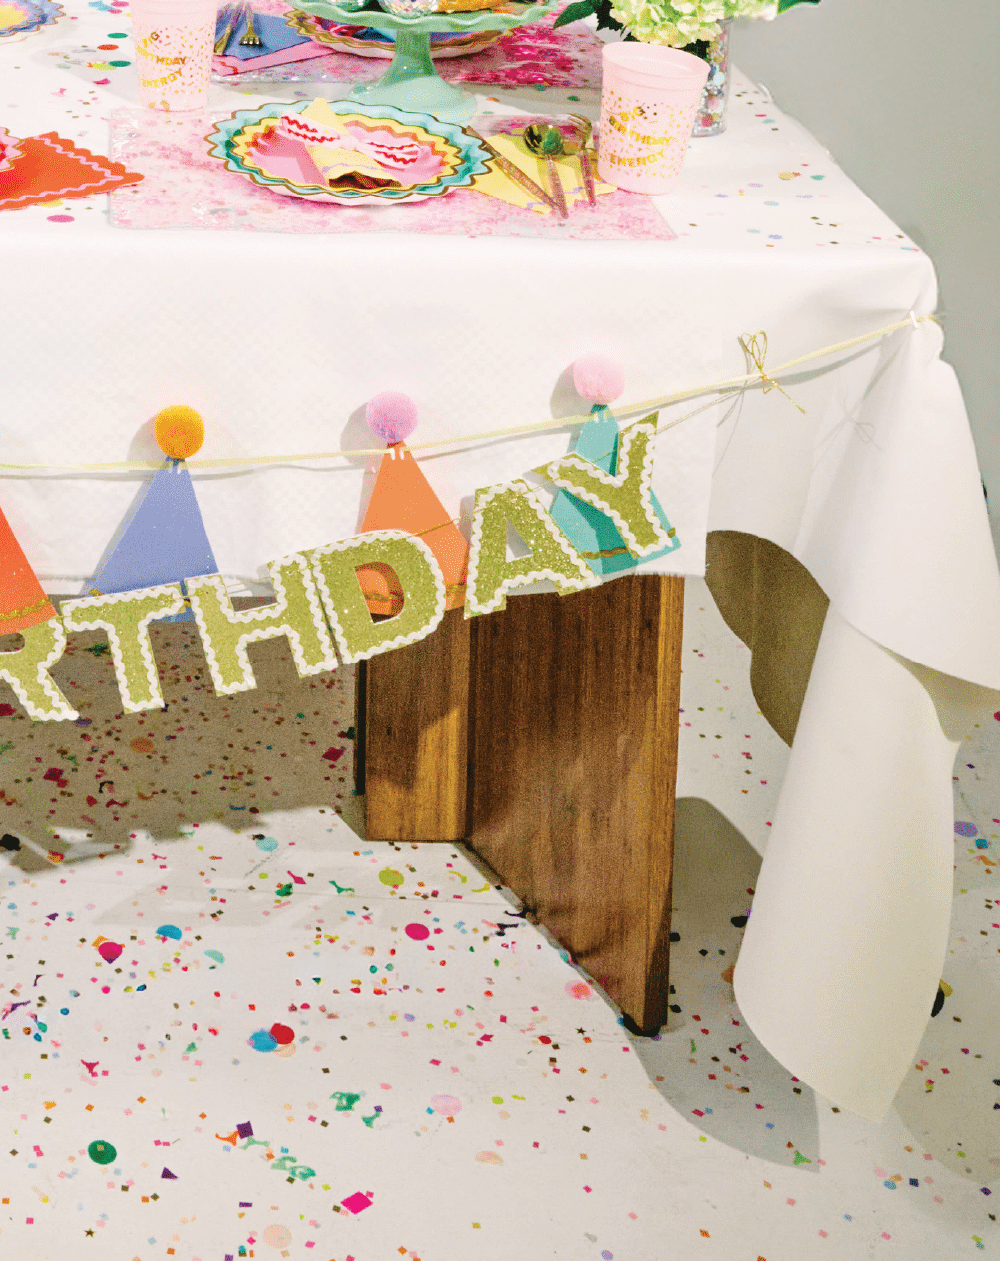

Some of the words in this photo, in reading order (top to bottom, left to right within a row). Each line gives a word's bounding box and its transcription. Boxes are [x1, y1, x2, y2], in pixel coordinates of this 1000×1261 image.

[619, 106, 645, 123] BIG
[608, 115, 673, 147] BIRTHDAY
[609, 148, 665, 168] ENERGY
